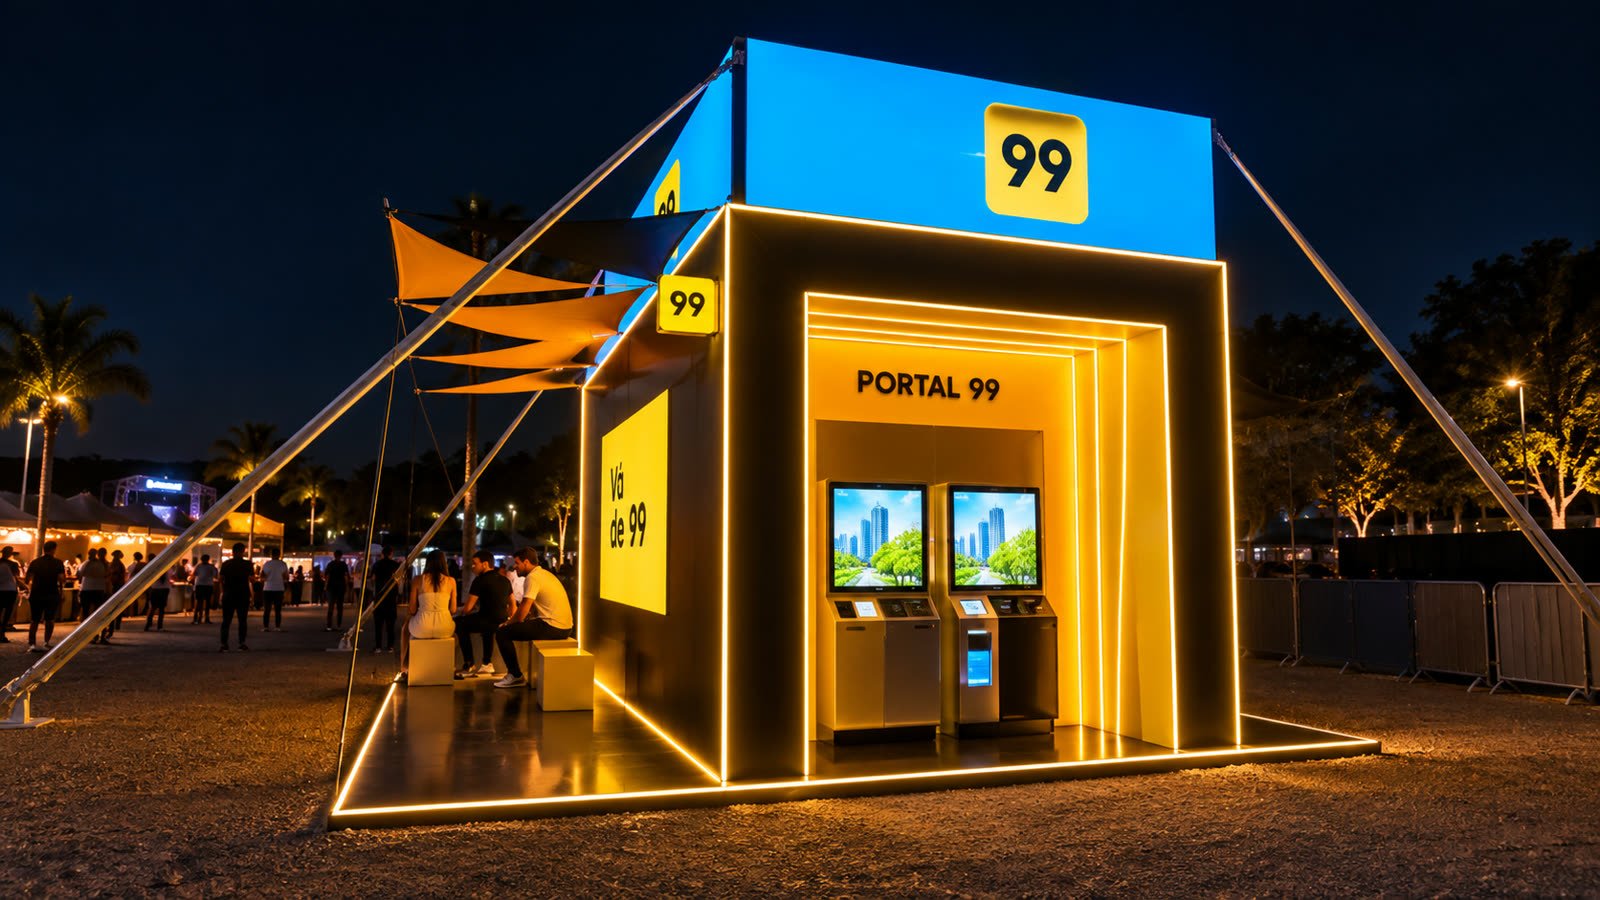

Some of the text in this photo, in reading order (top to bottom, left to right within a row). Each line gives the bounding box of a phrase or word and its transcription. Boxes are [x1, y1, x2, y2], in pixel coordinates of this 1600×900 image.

[1001, 133, 1072, 193] 99
[670, 290, 705, 317] 99
[857, 370, 1000, 401] PORTAL 99
[610, 461, 624, 502] Vá
[610, 501, 647, 549] de 99
